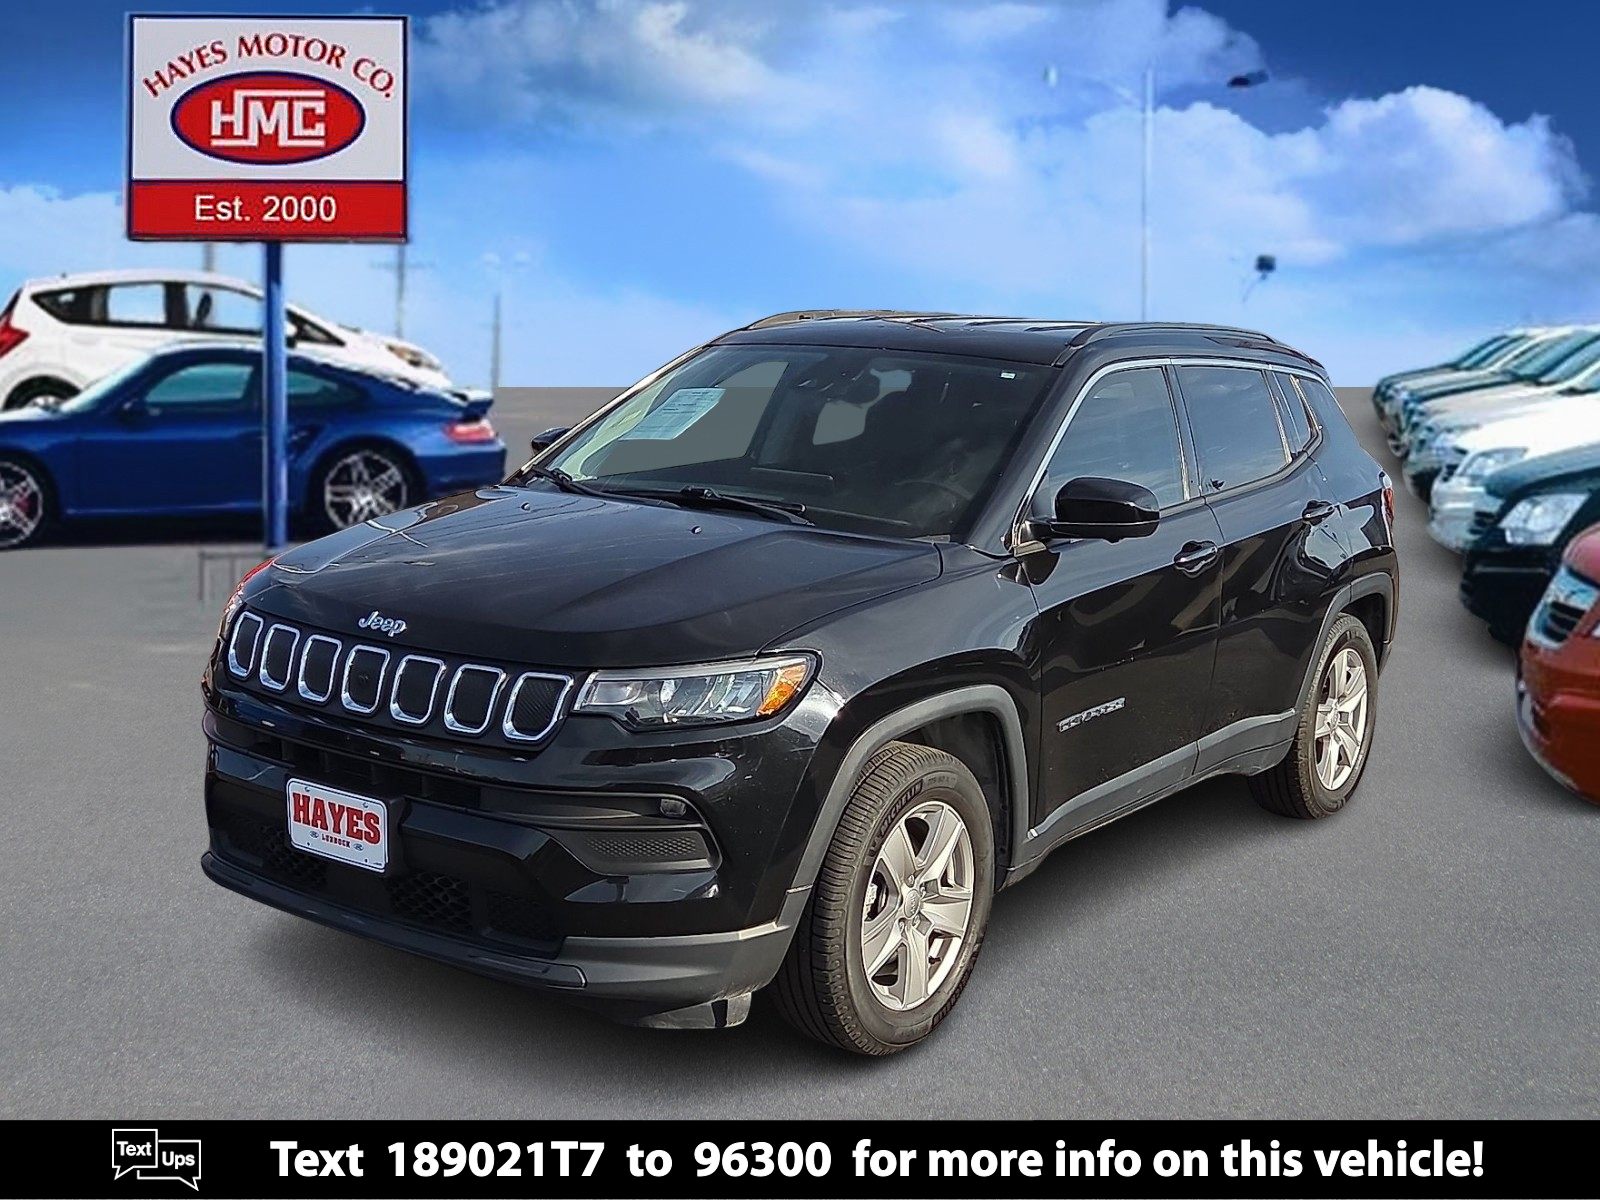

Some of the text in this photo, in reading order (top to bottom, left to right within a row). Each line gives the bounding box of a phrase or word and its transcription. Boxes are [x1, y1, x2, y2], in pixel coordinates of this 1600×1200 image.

[143, 33, 395, 98] HAYES MOTOR CO.
[210, 89, 326, 147] HMC
[194, 194, 337, 223] Est. 2000
[358, 610, 407, 638] Jeep
[292, 792, 381, 845] HAYES
